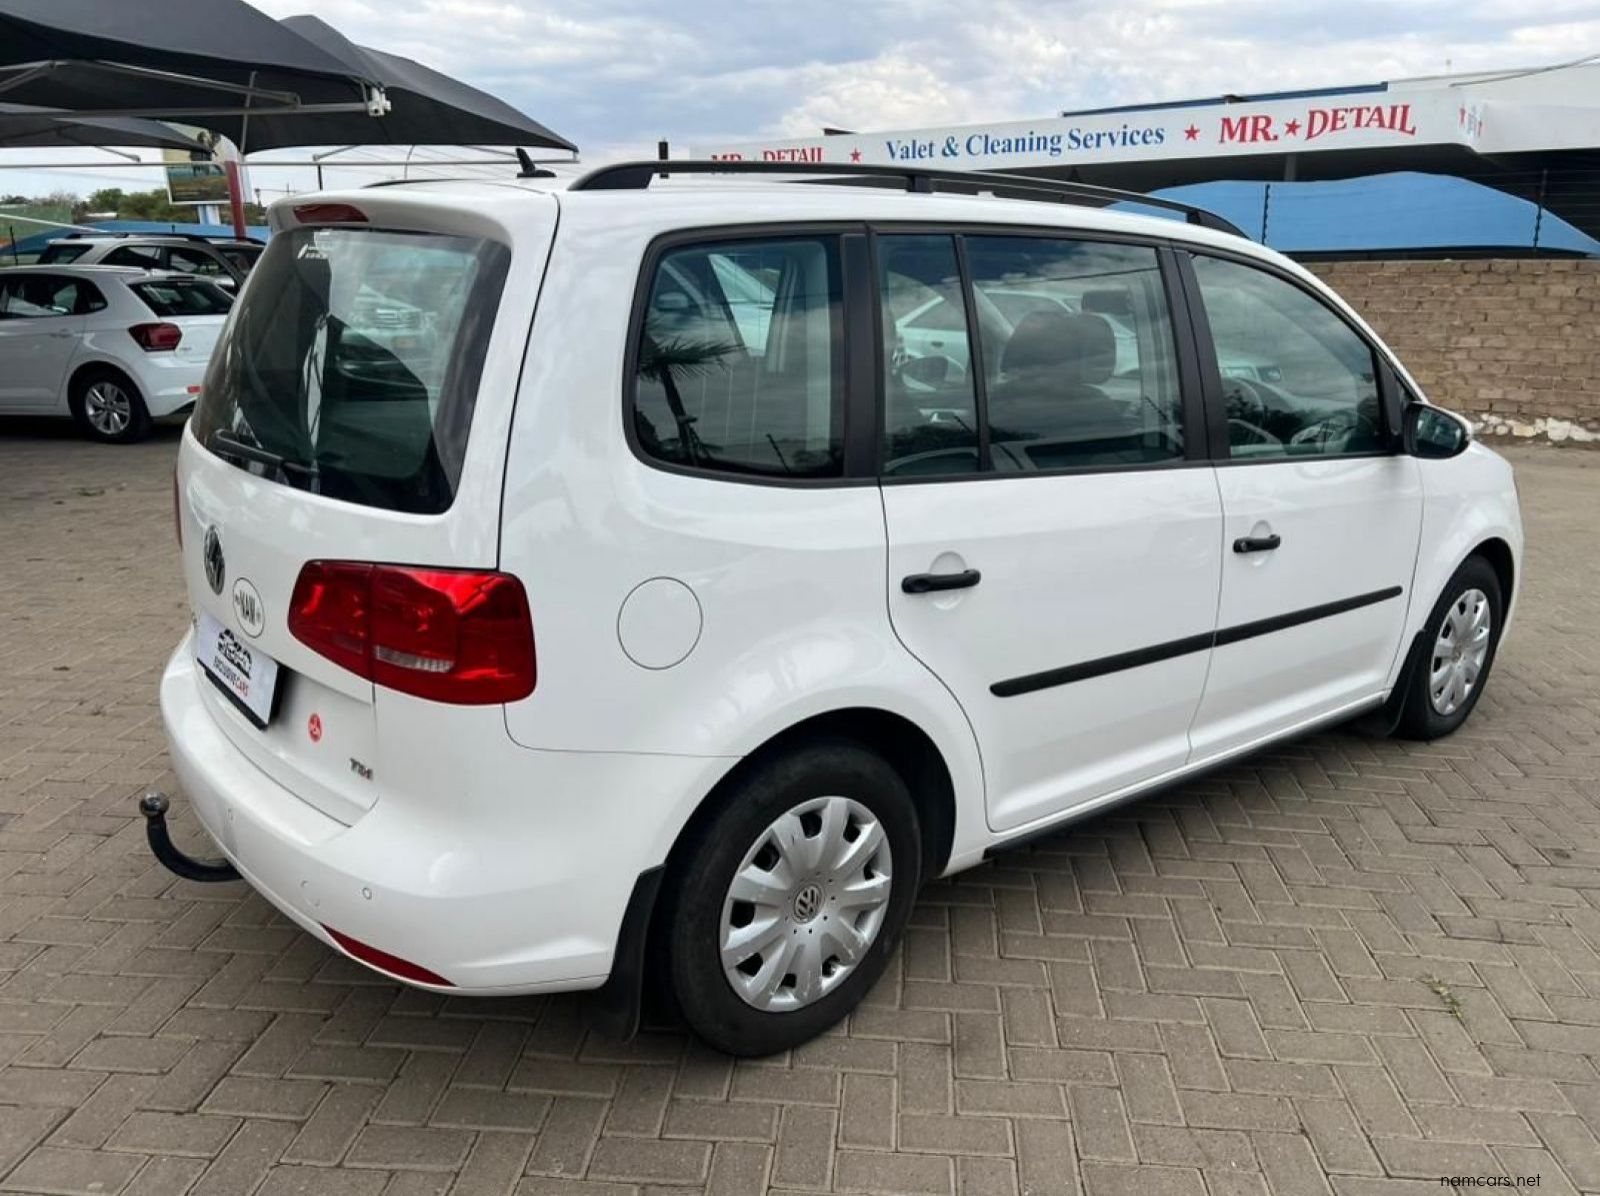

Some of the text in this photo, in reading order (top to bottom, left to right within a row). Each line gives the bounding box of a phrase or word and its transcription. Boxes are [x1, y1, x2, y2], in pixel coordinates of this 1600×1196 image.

[886, 124, 1165, 160] Valet & Cleaning Services
[1219, 104, 1416, 143] MR. DETAIL
